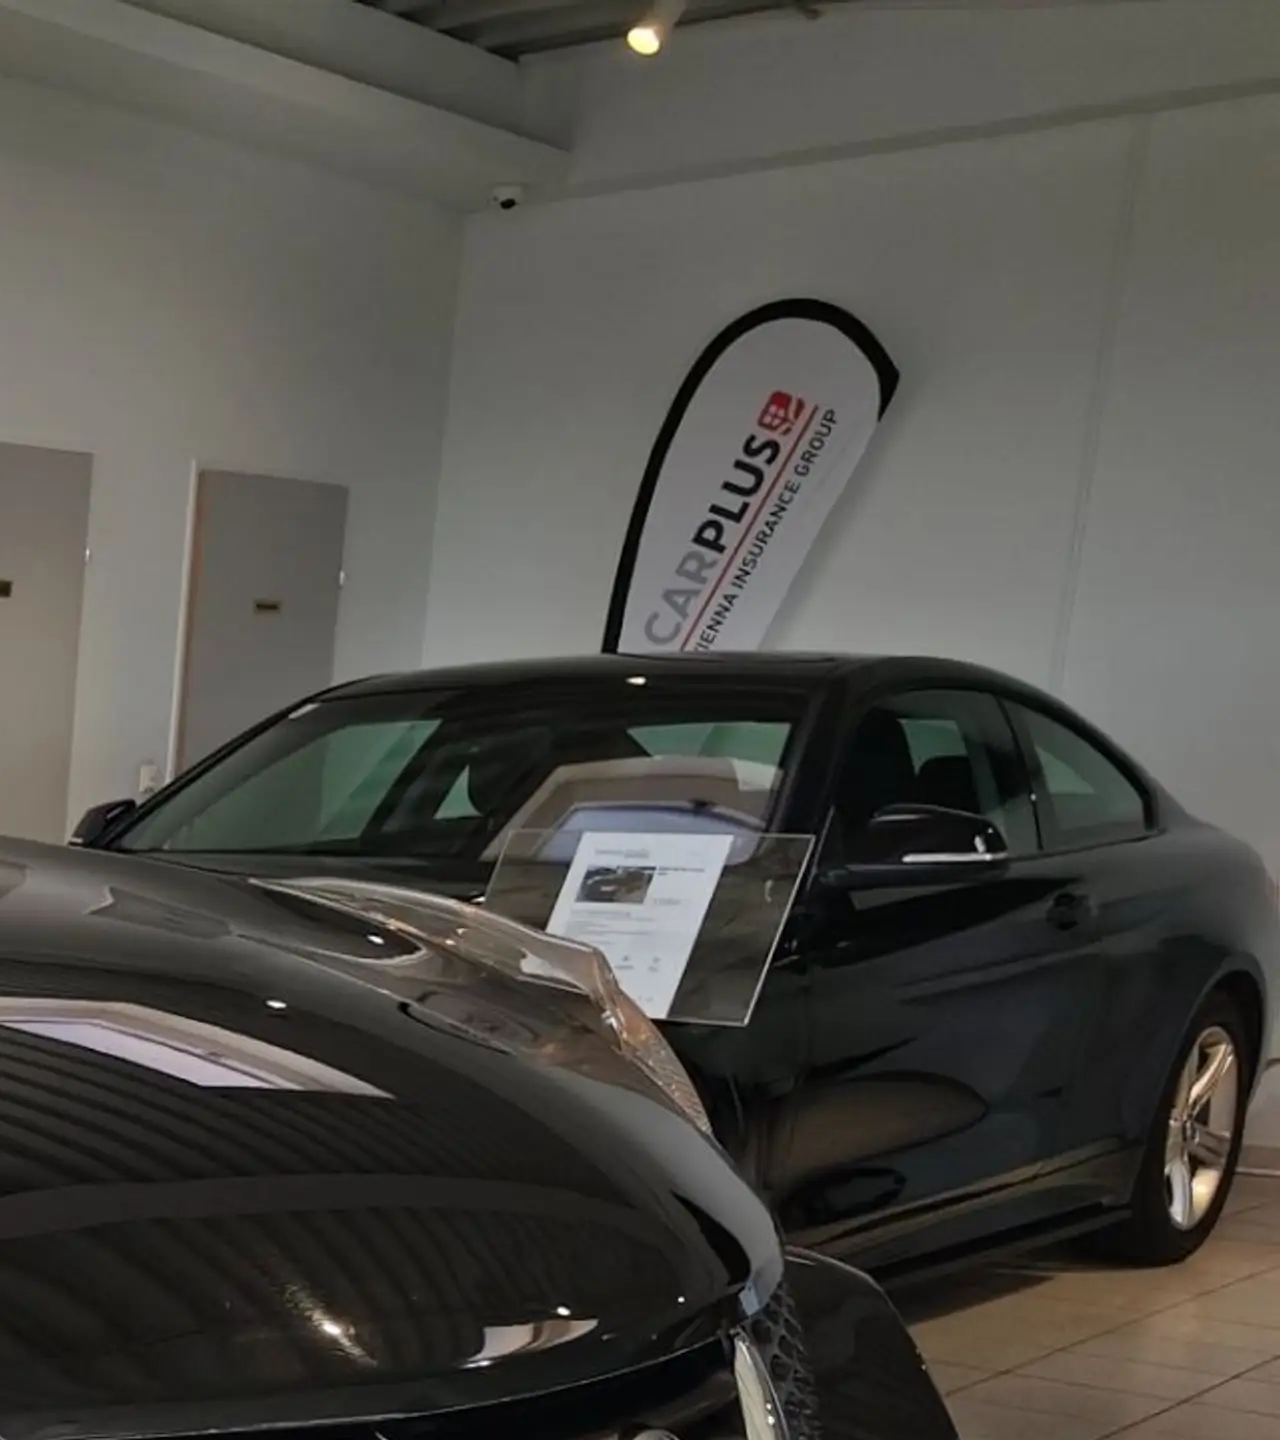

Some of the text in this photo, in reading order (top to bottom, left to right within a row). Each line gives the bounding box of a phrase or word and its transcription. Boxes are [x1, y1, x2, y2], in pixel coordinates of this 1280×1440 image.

[644, 433, 781, 646] CARPLUS
[694, 409, 838, 651] IENNA INSURANCE GROUP
